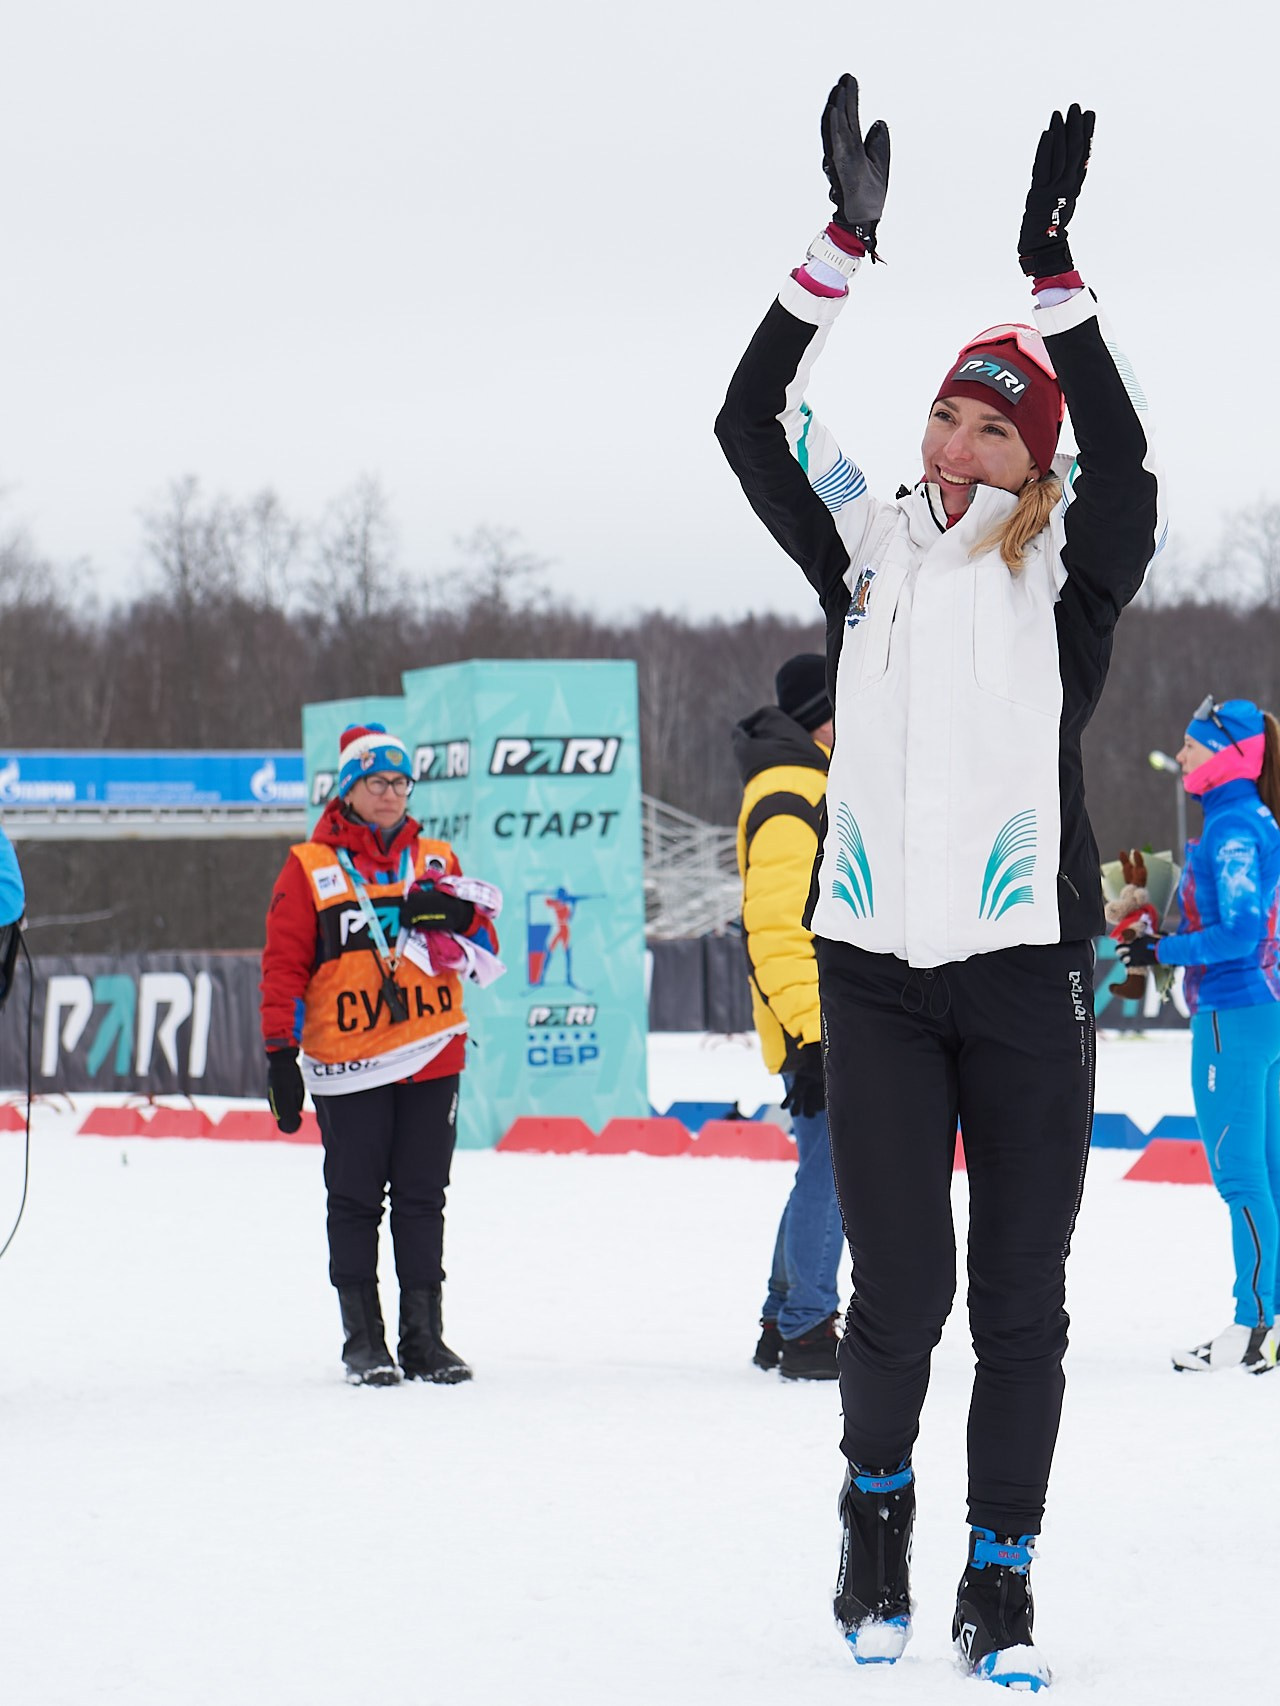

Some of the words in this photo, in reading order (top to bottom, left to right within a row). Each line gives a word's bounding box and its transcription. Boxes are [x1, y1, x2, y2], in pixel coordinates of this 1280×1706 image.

[959, 360, 1025, 394] PARI
[411, 741, 470, 781] PARI
[490, 737, 619, 775] PARI
[493, 810, 619, 838] СТАРТ
[41, 971, 213, 1079] PARI
[336, 985, 453, 1033] СУЬЯ
[528, 1046, 600, 1066] СБР
